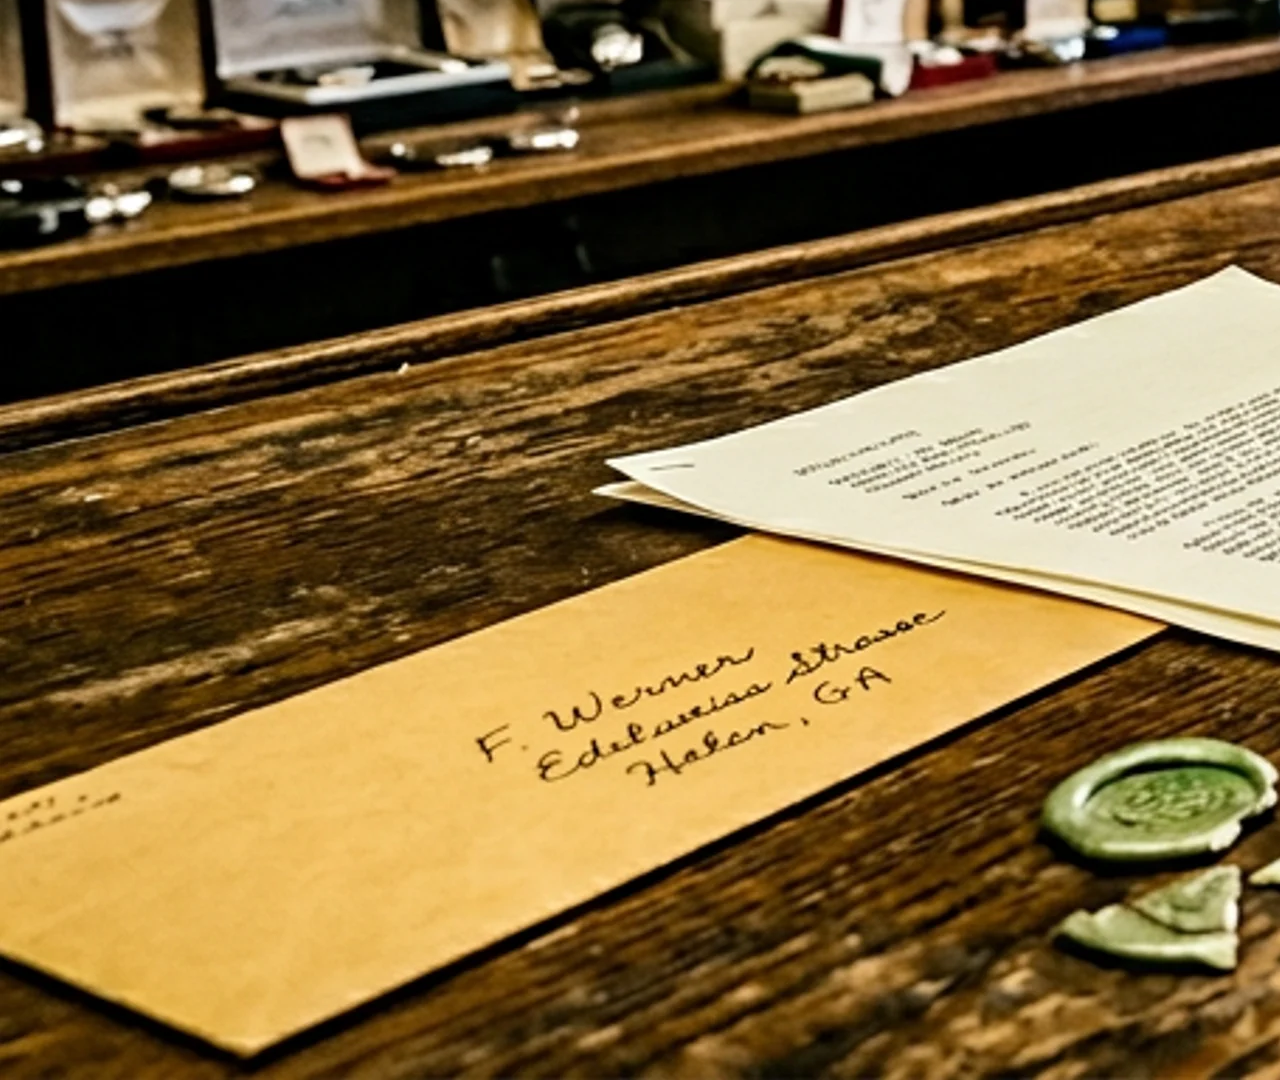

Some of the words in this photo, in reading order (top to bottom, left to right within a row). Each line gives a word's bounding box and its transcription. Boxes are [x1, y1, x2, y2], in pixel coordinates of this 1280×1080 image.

[475, 723, 529, 763] F.
[542, 647, 755, 732] Werner
[813, 666, 893, 705] GA
